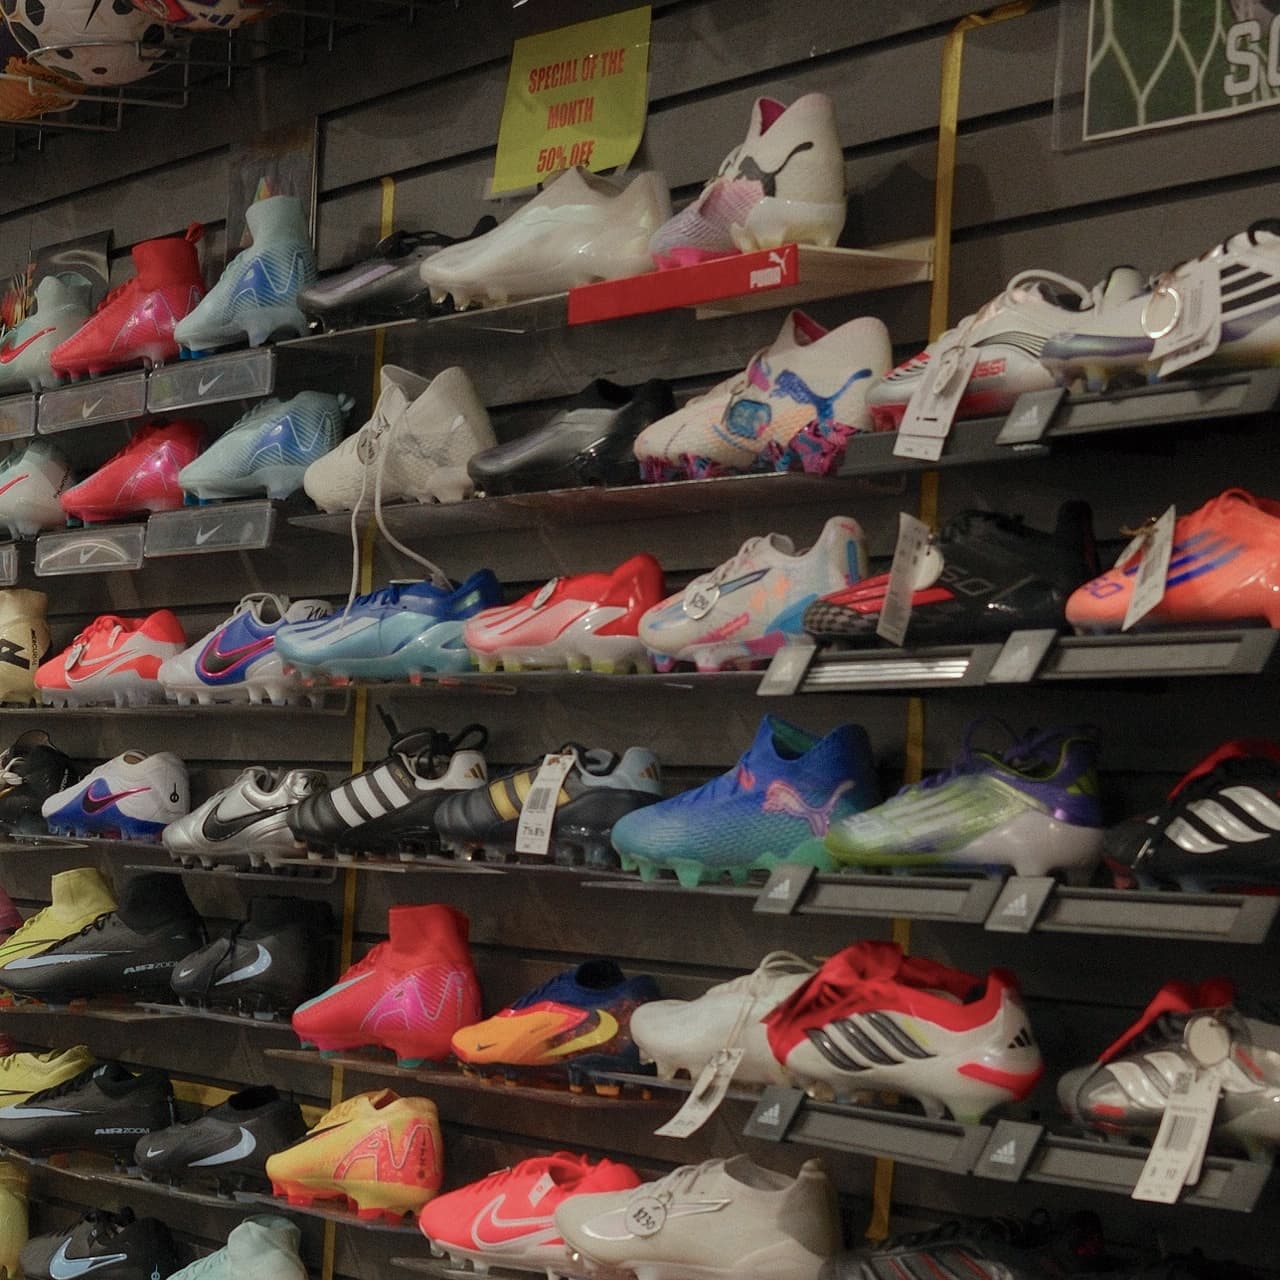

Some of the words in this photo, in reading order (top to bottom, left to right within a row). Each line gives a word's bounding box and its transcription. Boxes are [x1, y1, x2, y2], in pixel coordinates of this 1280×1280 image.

[528, 58, 578, 94] SPECIAL
[581, 54, 598, 81] OF
[601, 48, 625, 78] THE
[547, 97, 594, 130] MONTH
[537, 145, 568, 173] 50%
[570, 140, 595, 168] OFF
